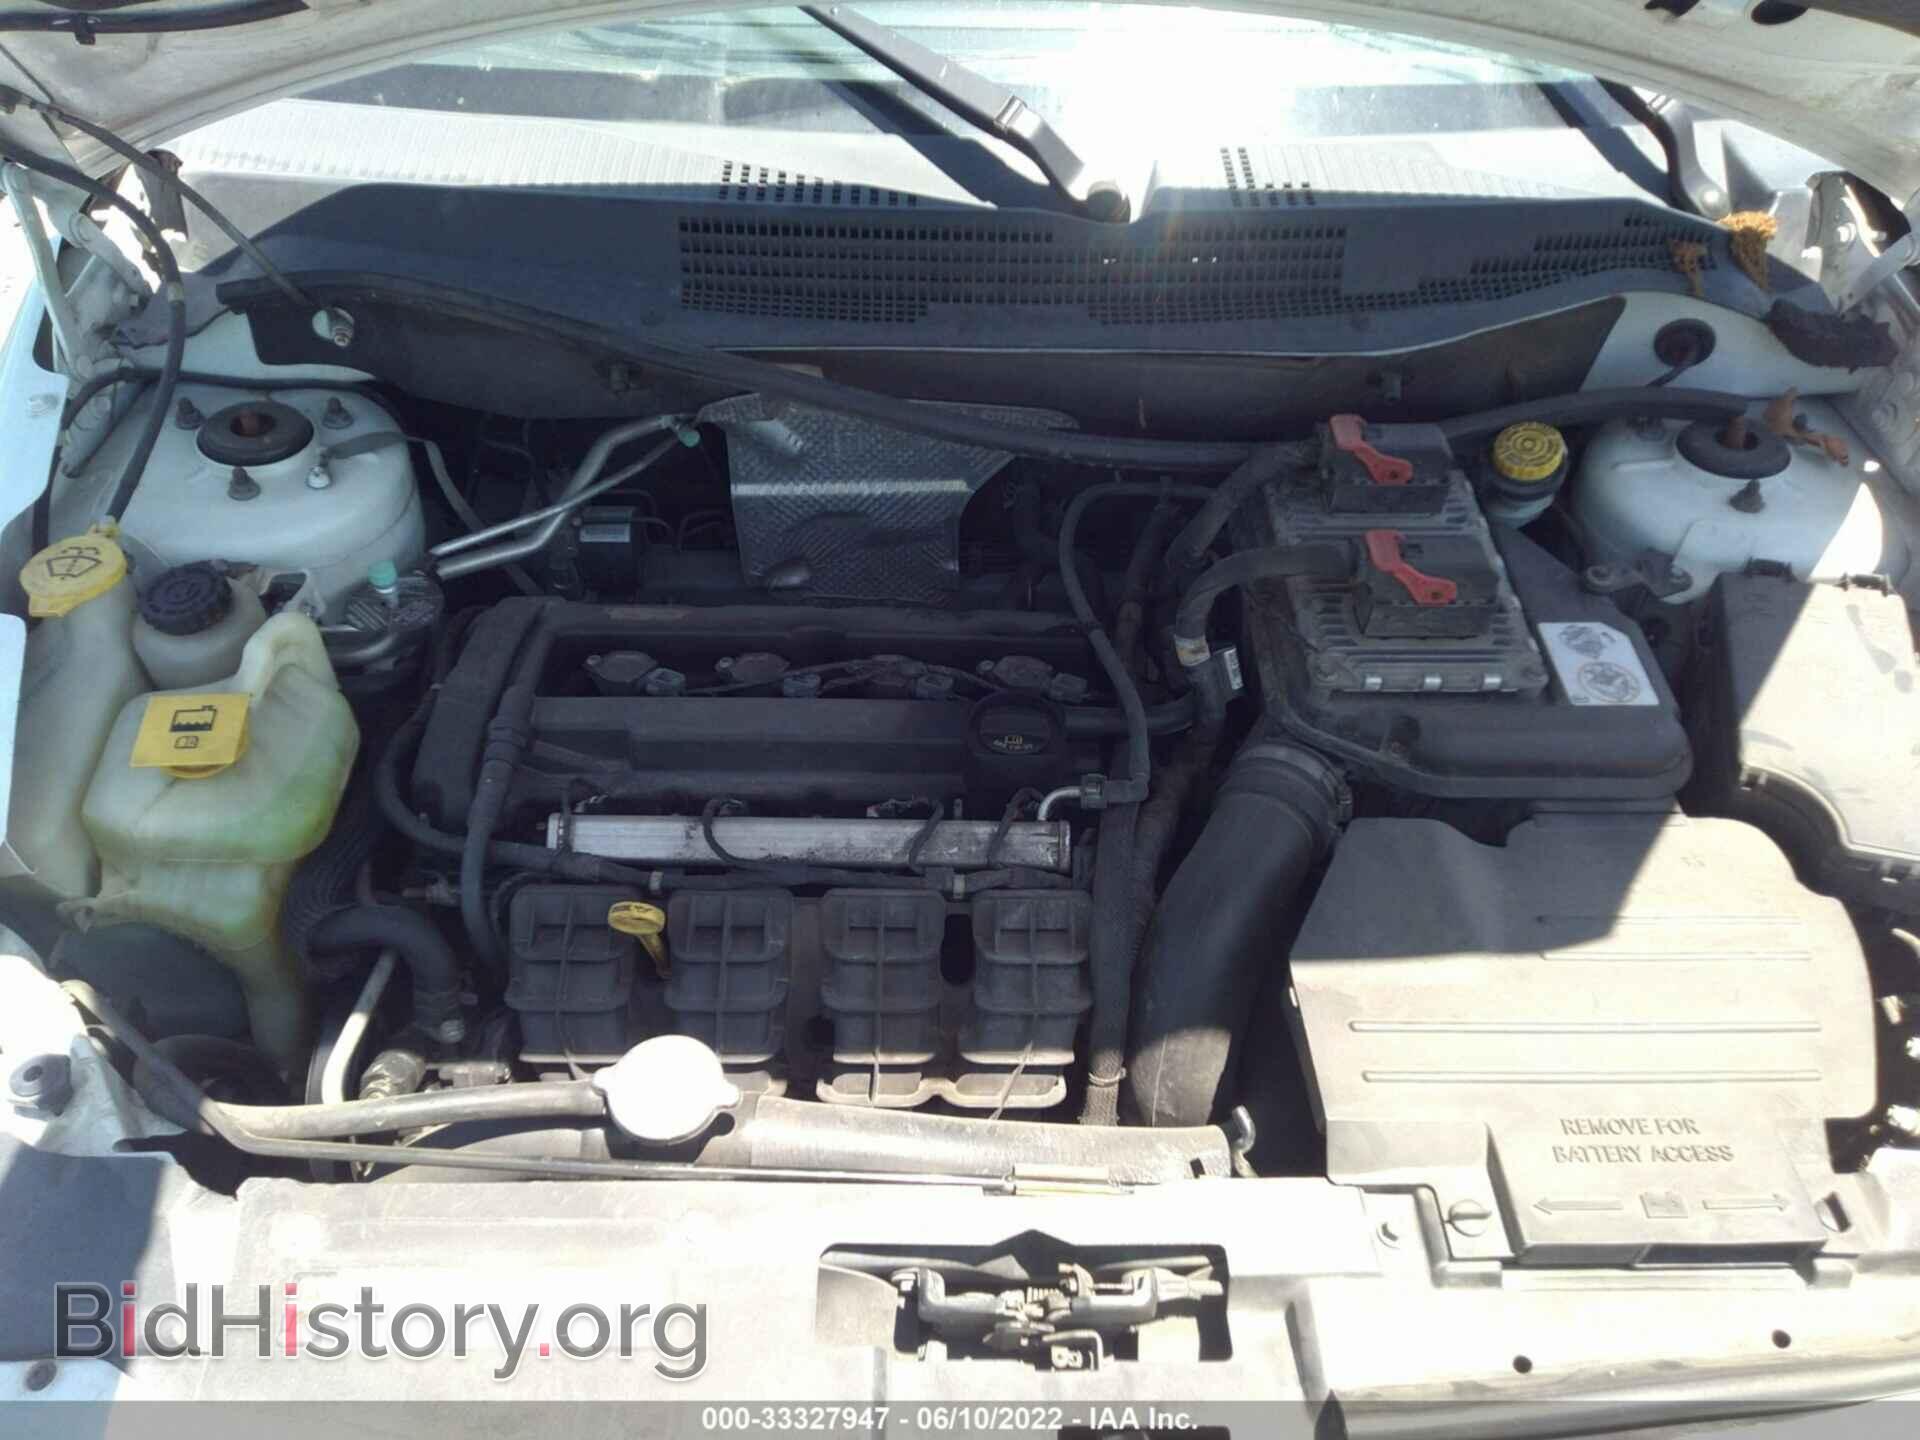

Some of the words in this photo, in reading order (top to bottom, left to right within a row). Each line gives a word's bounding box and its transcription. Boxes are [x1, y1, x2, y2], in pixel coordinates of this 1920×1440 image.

[1559, 1117, 1652, 1136] REMOVE
[1653, 1117, 1701, 1136] FOR
[1552, 1145, 1642, 1164] BATTERY
[1650, 1145, 1735, 1163] ACCESS
